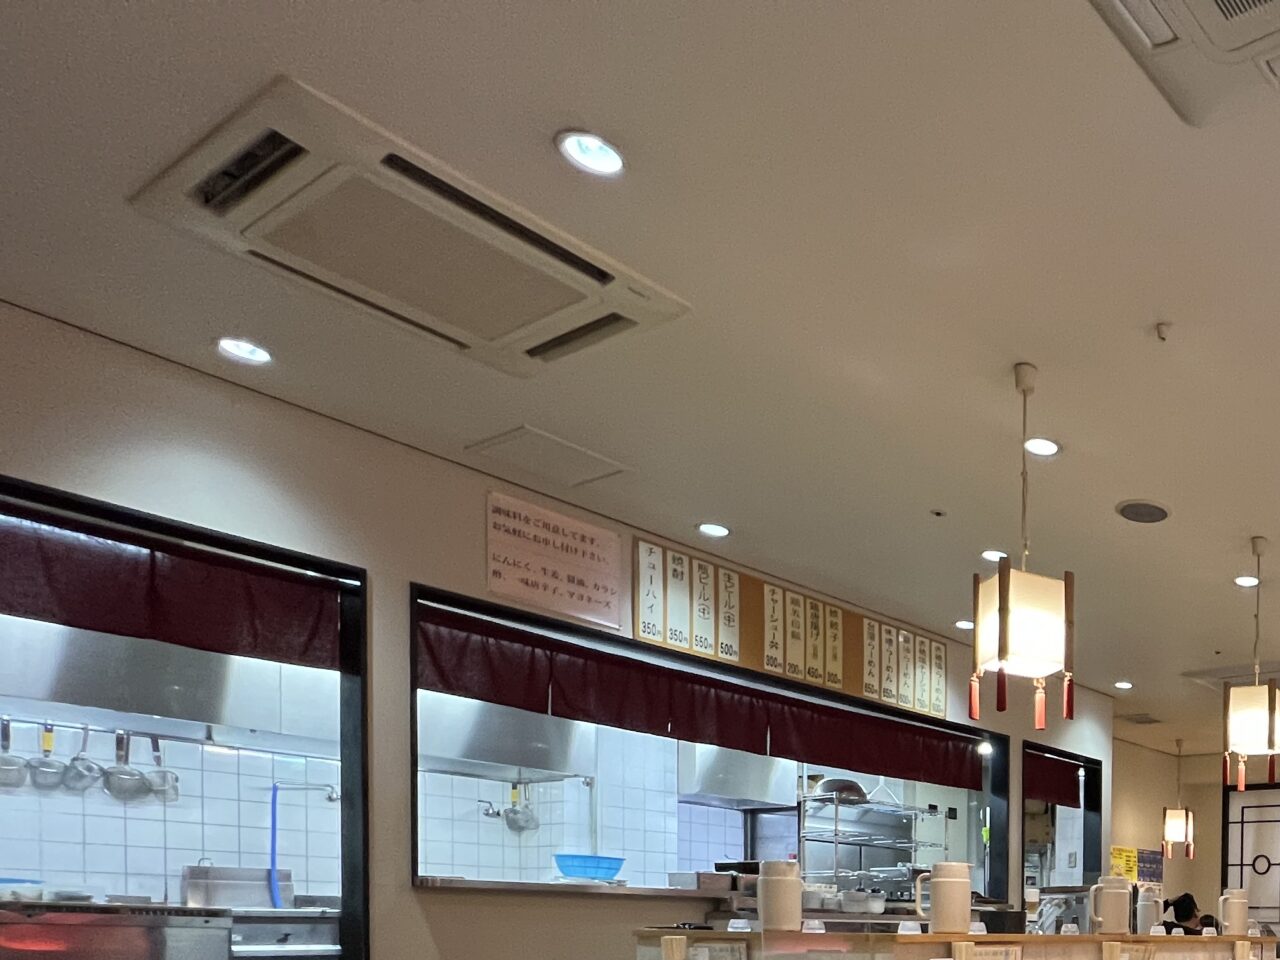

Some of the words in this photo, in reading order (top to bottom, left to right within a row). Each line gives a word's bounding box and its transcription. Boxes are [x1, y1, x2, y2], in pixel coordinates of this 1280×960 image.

[646, 547, 656, 613] チューハイ
